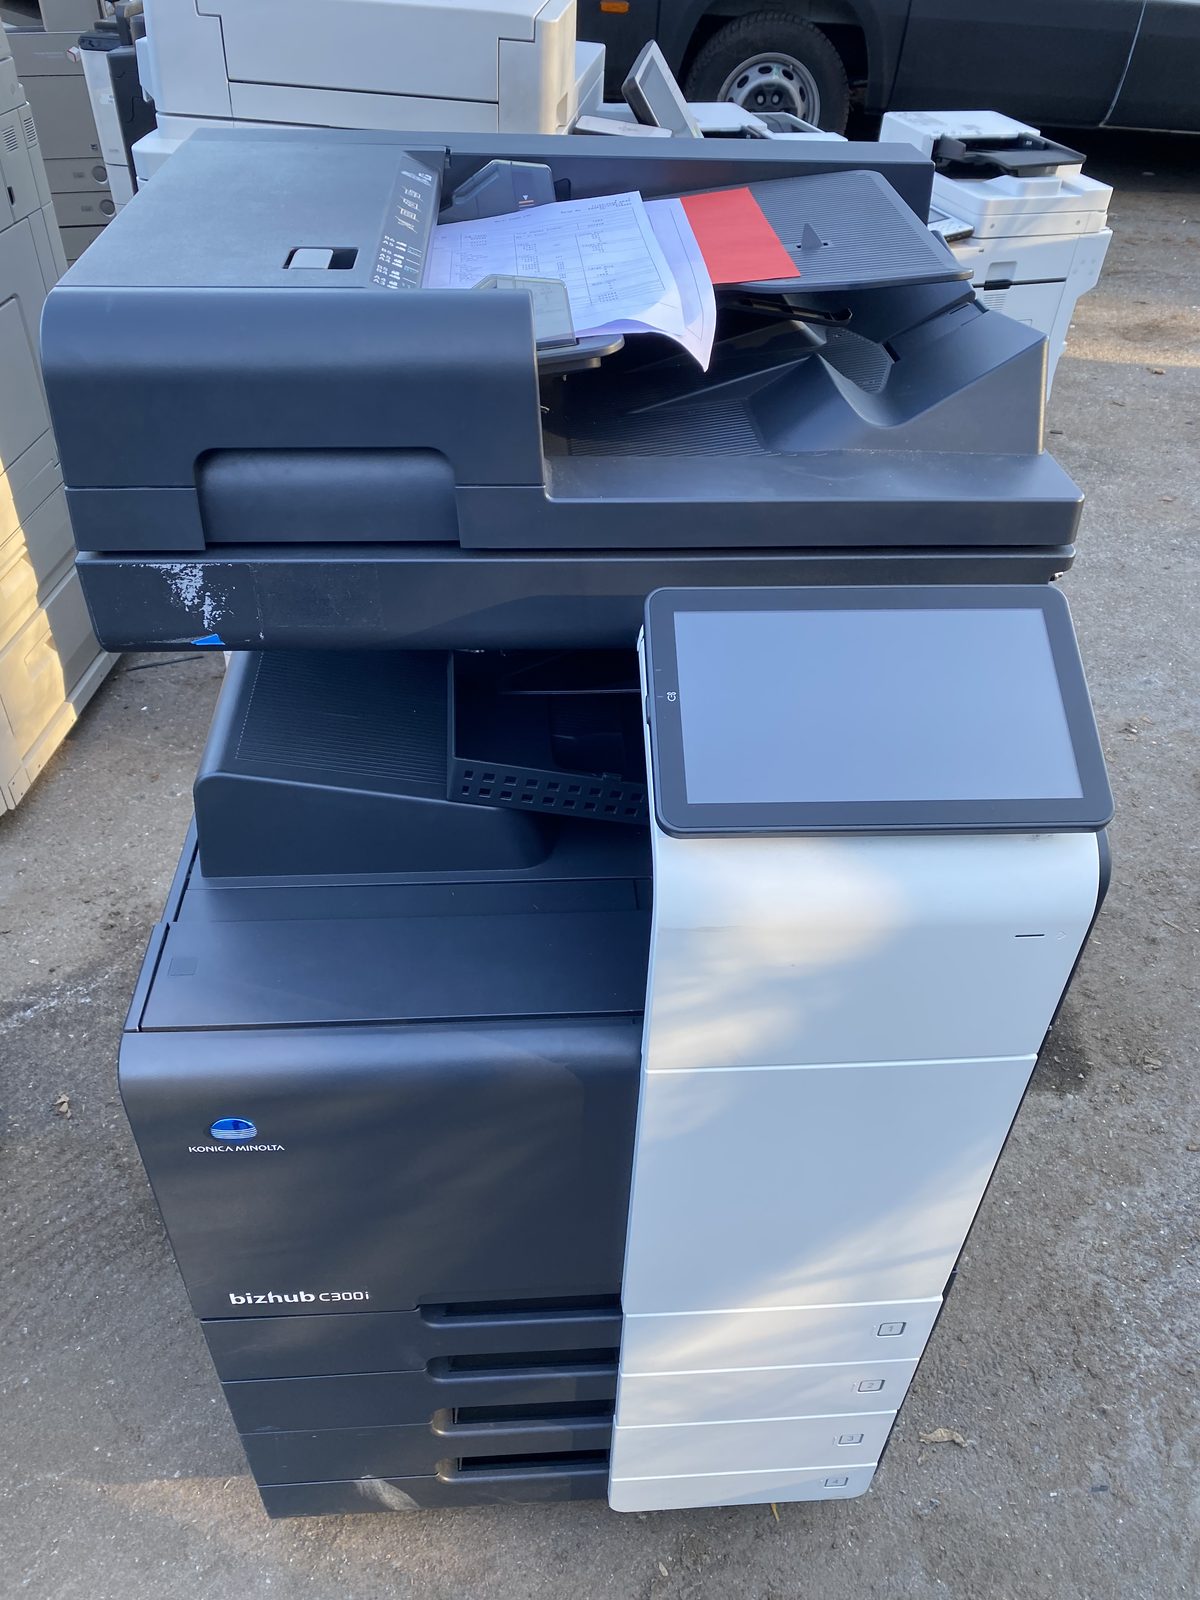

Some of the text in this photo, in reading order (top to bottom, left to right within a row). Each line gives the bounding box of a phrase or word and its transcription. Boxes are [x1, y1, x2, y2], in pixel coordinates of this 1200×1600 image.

[188, 1144, 285, 1153] KONICA MINOLTA
[229, 1291, 370, 1305] bizhub C300i
